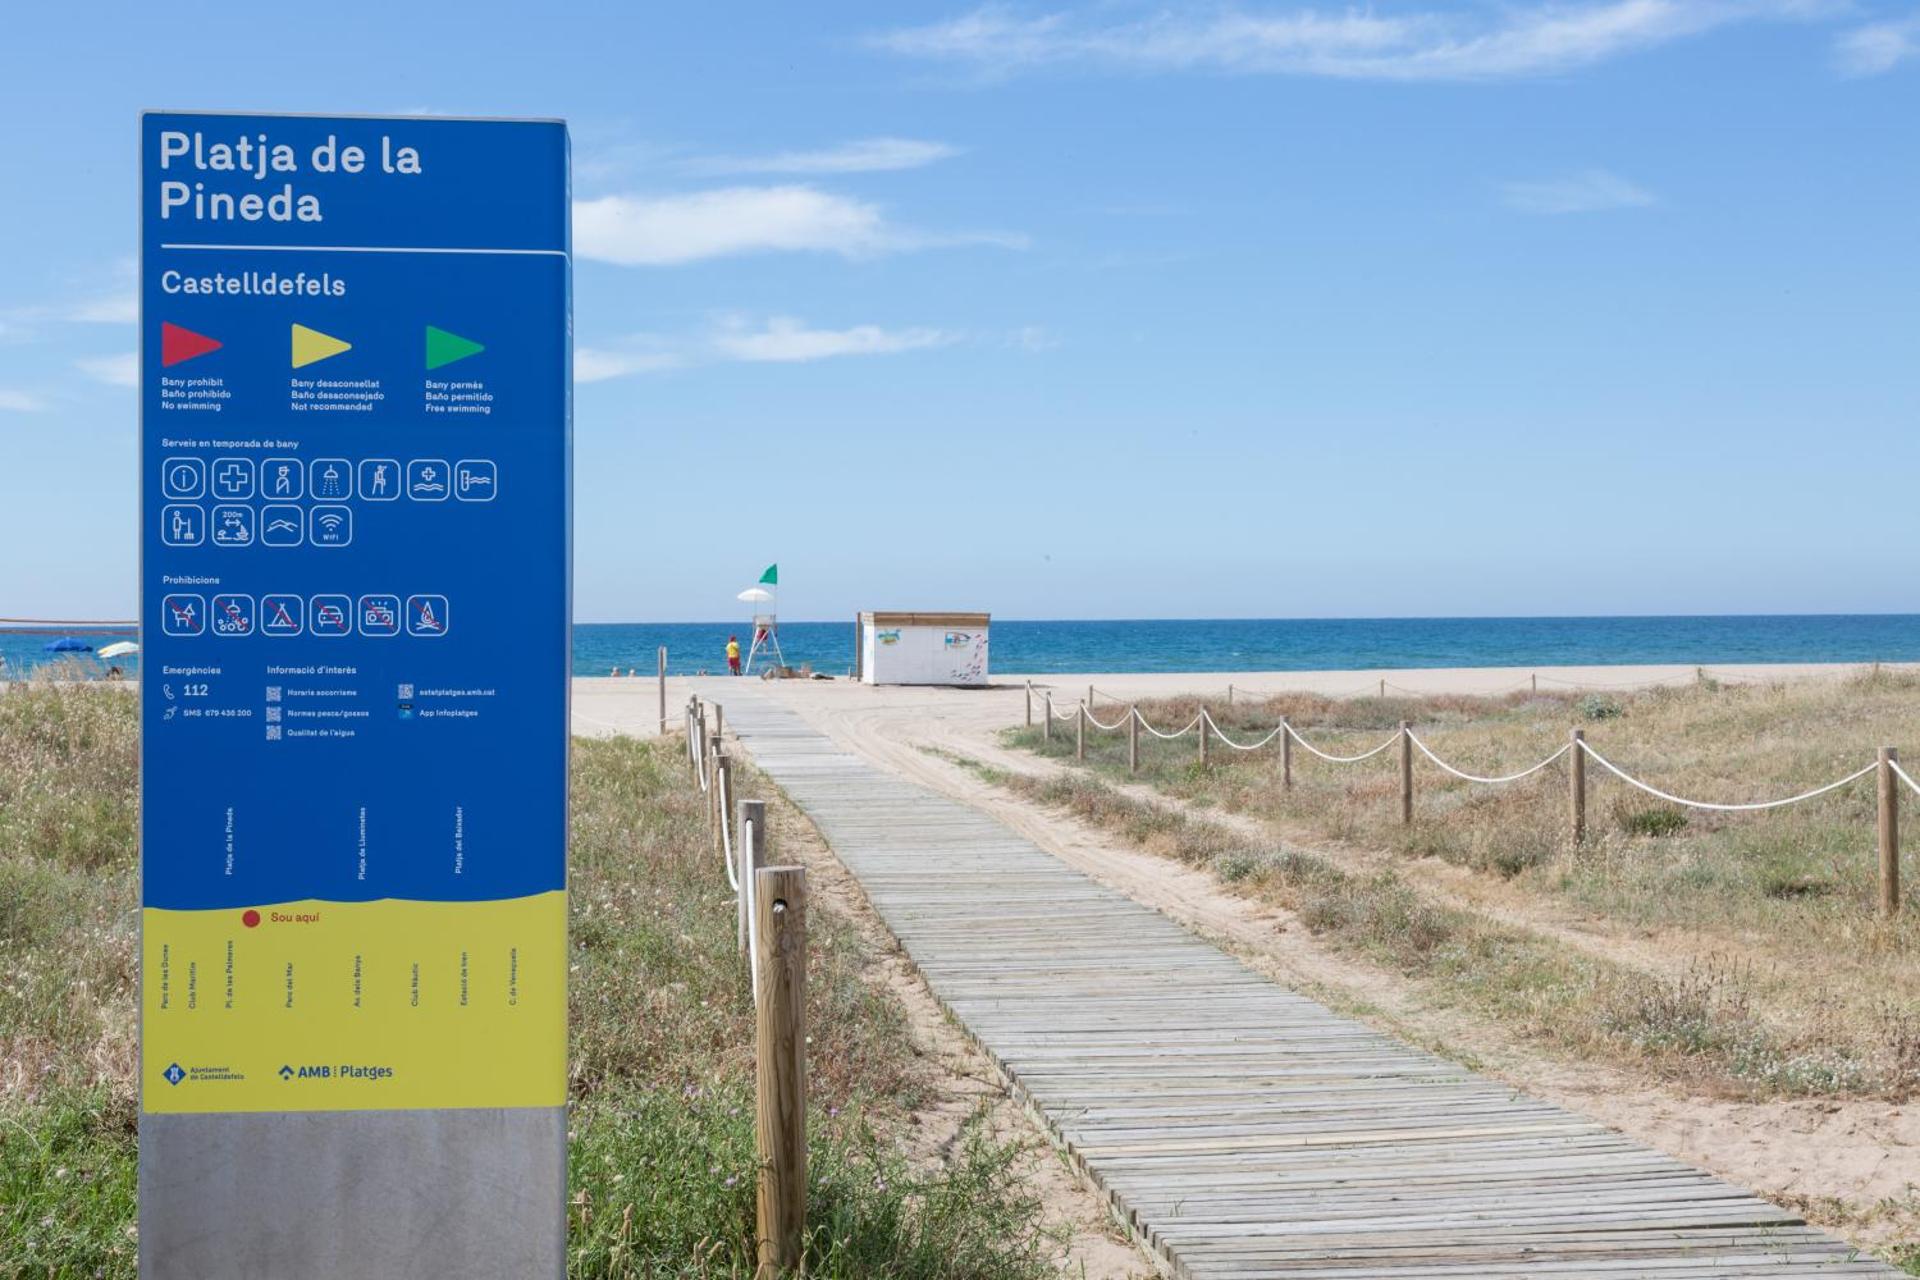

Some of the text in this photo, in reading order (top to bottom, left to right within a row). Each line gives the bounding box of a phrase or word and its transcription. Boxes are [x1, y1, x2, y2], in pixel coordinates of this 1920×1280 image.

[160, 131, 423, 180] Platja de la
[160, 181, 323, 222] Pineda
[161, 271, 346, 297] Castelldefels
[161, 377, 224, 388] Bany prohibit
[291, 378, 380, 390] Bany desaconsellat
[425, 380, 449, 391] Bany
[161, 388, 232, 400] Baño prohibido
[291, 390, 385, 401] Baño desaconsejado
[425, 391, 494, 403] Baño permitido
[161, 401, 221, 412] No swimming
[291, 402, 373, 411] Not recommended
[425, 404, 491, 415] Free swimming
[161, 438, 197, 448] Serveis
[212, 439, 261, 450] temporada
[263, 439, 275, 448] de
[277, 440, 299, 450] bany
[163, 576, 220, 585] Prohibicions
[183, 684, 208, 696] 112
[271, 912, 293, 922] Sou
[298, 1065, 393, 1081] AMB Platges
